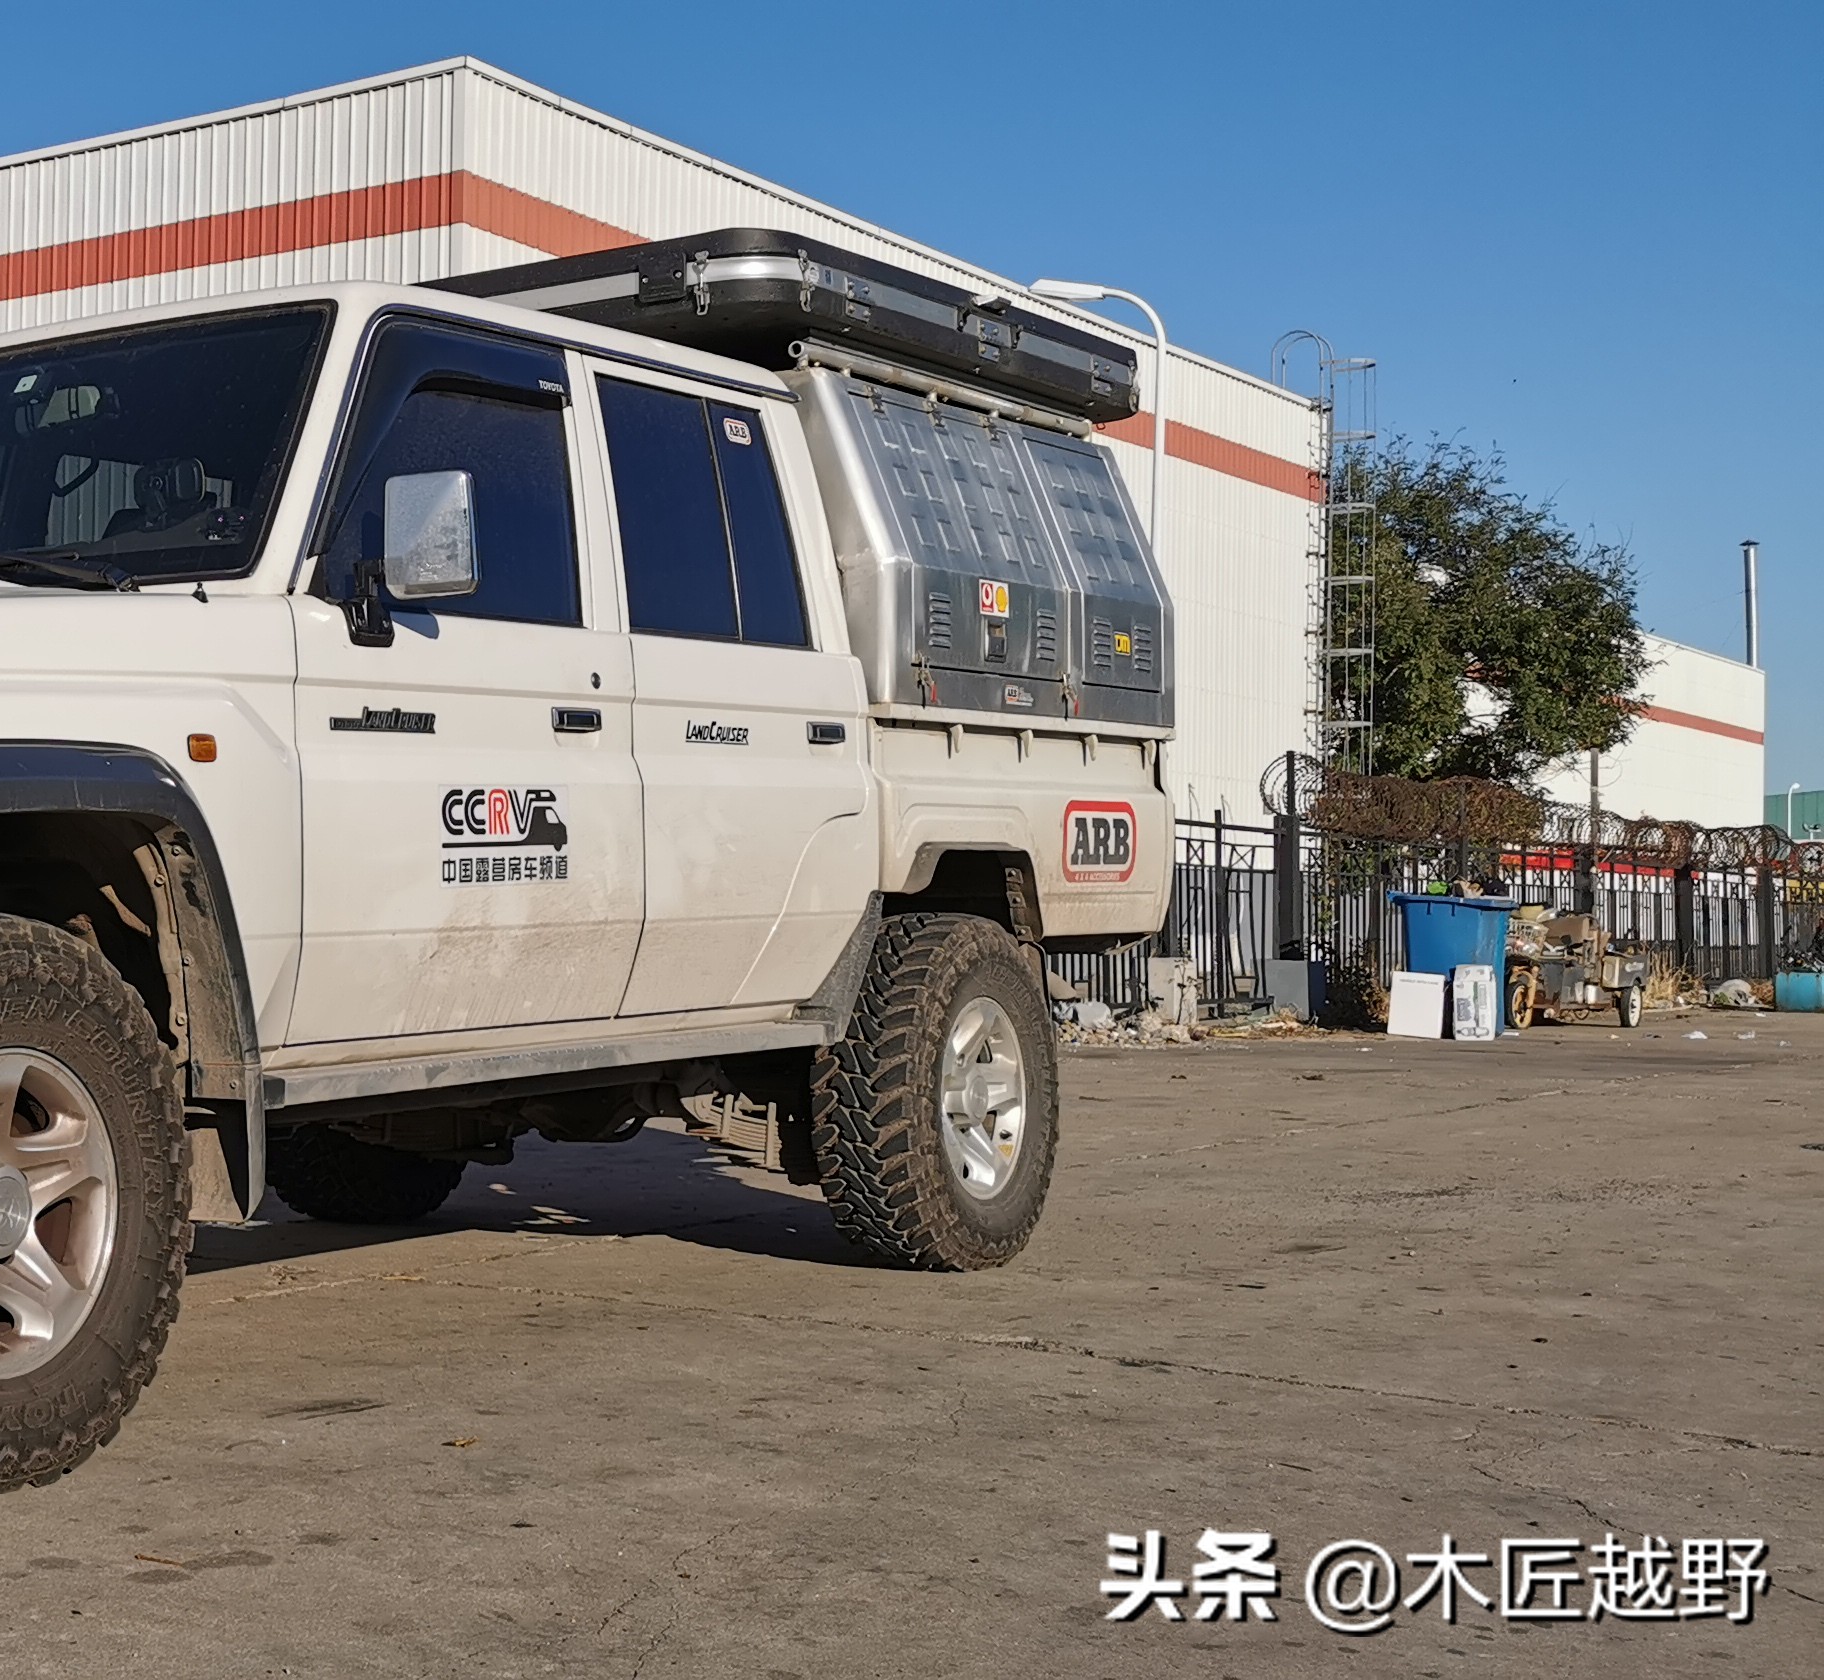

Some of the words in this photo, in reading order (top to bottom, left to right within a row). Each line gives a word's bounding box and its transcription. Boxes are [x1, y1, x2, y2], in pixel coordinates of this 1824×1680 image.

[728, 424, 747, 439] ARB
[1070, 816, 1130, 866] ARB
[441, 855, 568, 884] 中国露营房车频道
